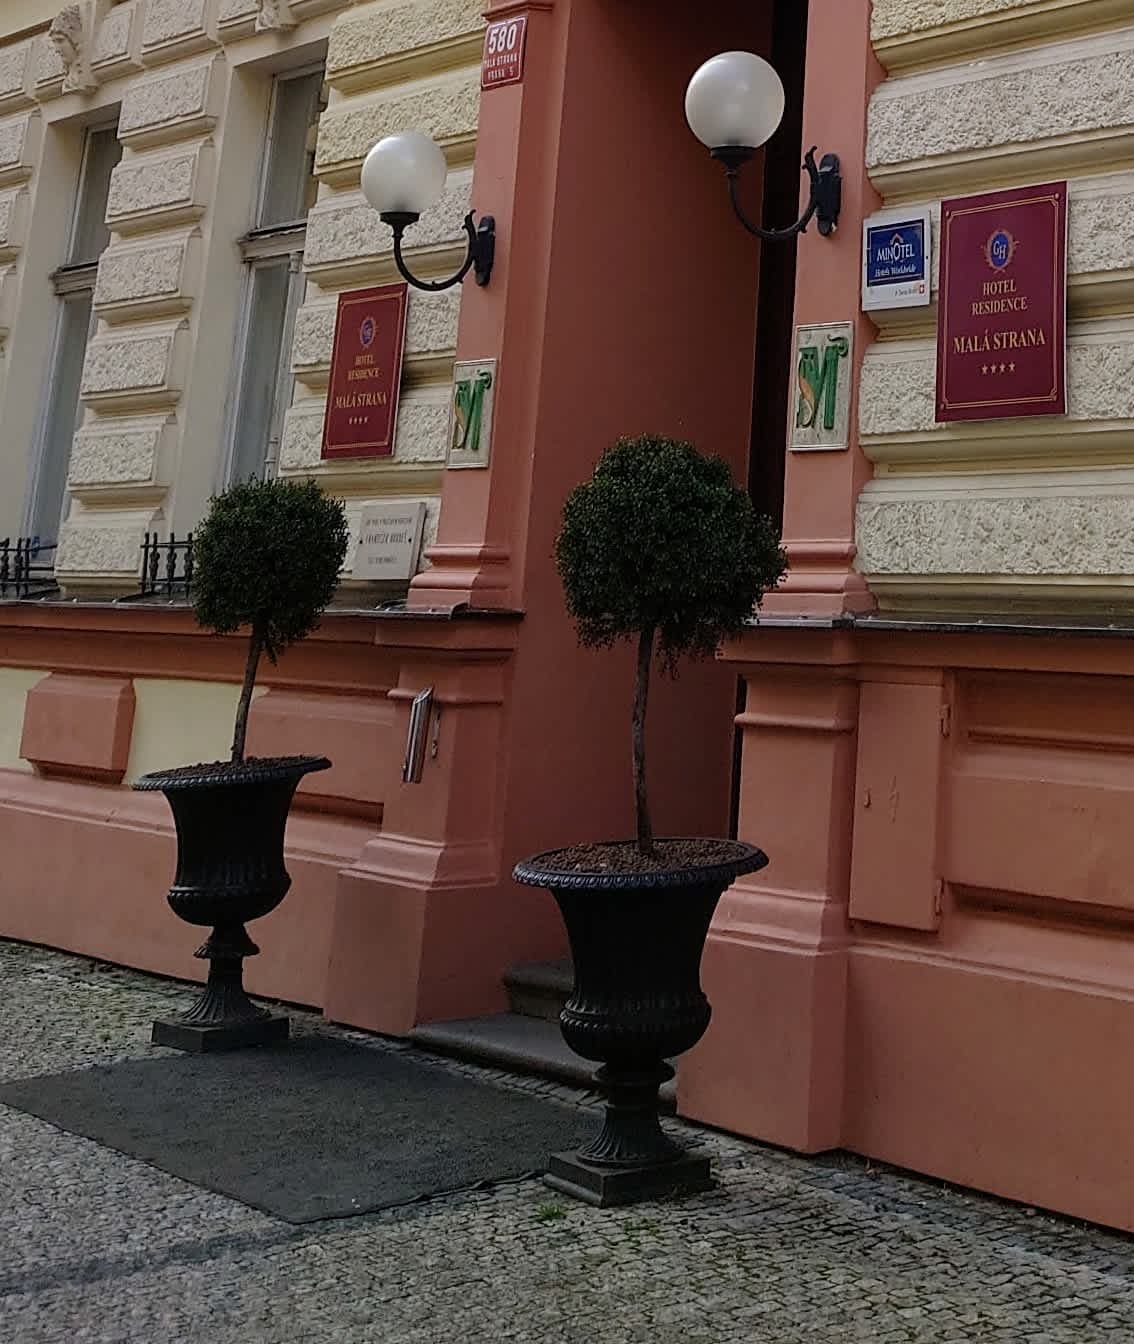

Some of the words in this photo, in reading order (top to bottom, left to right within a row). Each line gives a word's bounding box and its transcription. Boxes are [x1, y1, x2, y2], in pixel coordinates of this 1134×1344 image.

[488, 23, 518, 54] 580
[876, 242, 916, 262] MINOTEL
[983, 279, 1017, 296] HOTEL
[971, 296, 1028, 316] RESIDENCE
[953, 329, 990, 354] MALÁ
[993, 328, 1046, 350] STRANA
[357, 392, 387, 407] STRANA
